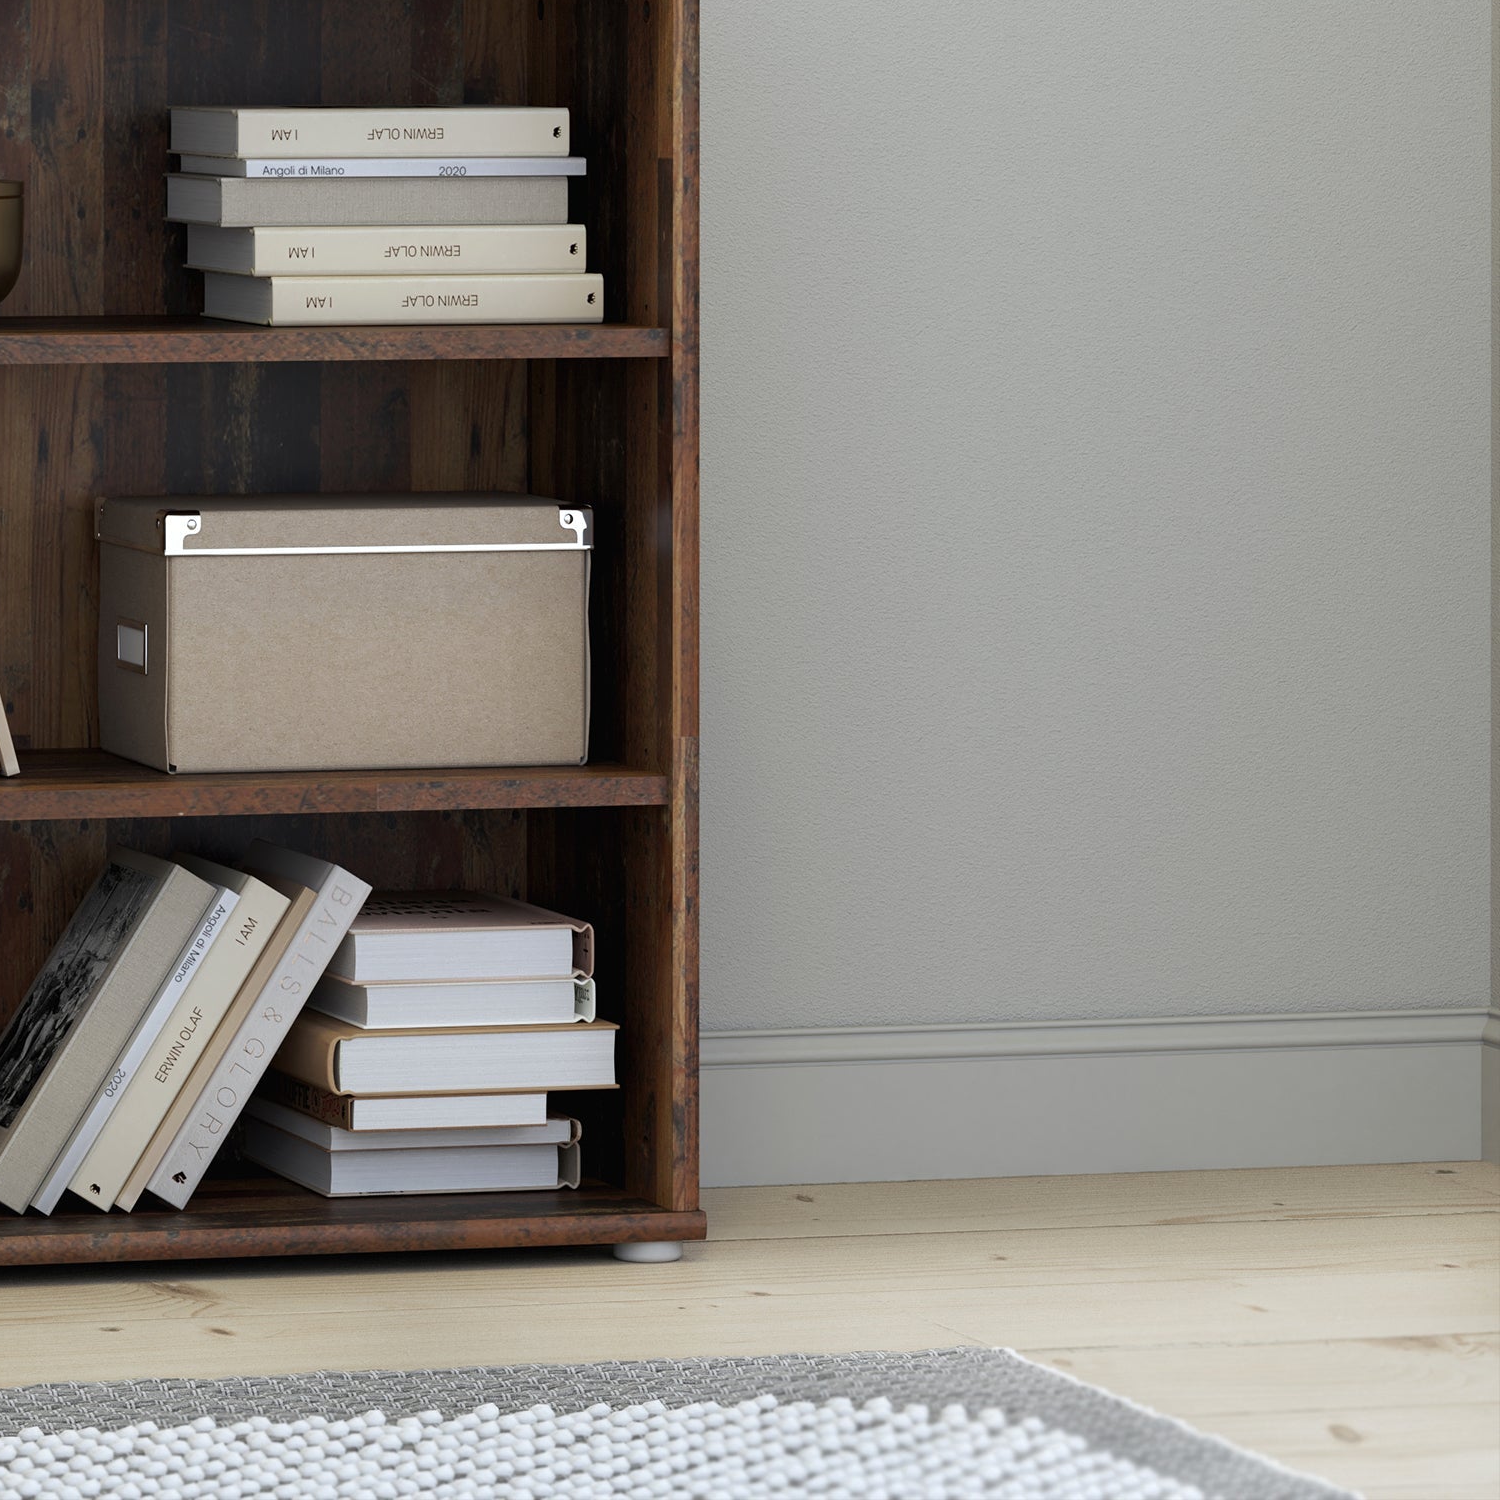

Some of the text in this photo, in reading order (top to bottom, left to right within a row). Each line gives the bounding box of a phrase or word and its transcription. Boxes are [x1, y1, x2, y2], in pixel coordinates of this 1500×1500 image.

[271, 128, 294, 141] AM
[367, 128, 400, 141] OLAF
[403, 127, 444, 141] ERWIN
[262, 165, 467, 177] Angoli di Milano 2020
[288, 246, 311, 259] AM
[384, 245, 417, 258] OLAF
[419, 245, 460, 258] ERWIN
[305, 296, 329, 309] AM
[401, 295, 434, 308] OLAF
[437, 294, 478, 308] ERWIN
[280, 884, 353, 996] BALLS
[104, 904, 226, 1098] Angoli di Milano 2020
[154, 1041, 186, 1084] ERWIN
[179, 1006, 204, 1041] OLAF
[240, 916, 258, 941] AM
[262, 1007, 283, 1023] &
[188, 1038, 265, 1161] GLORY
